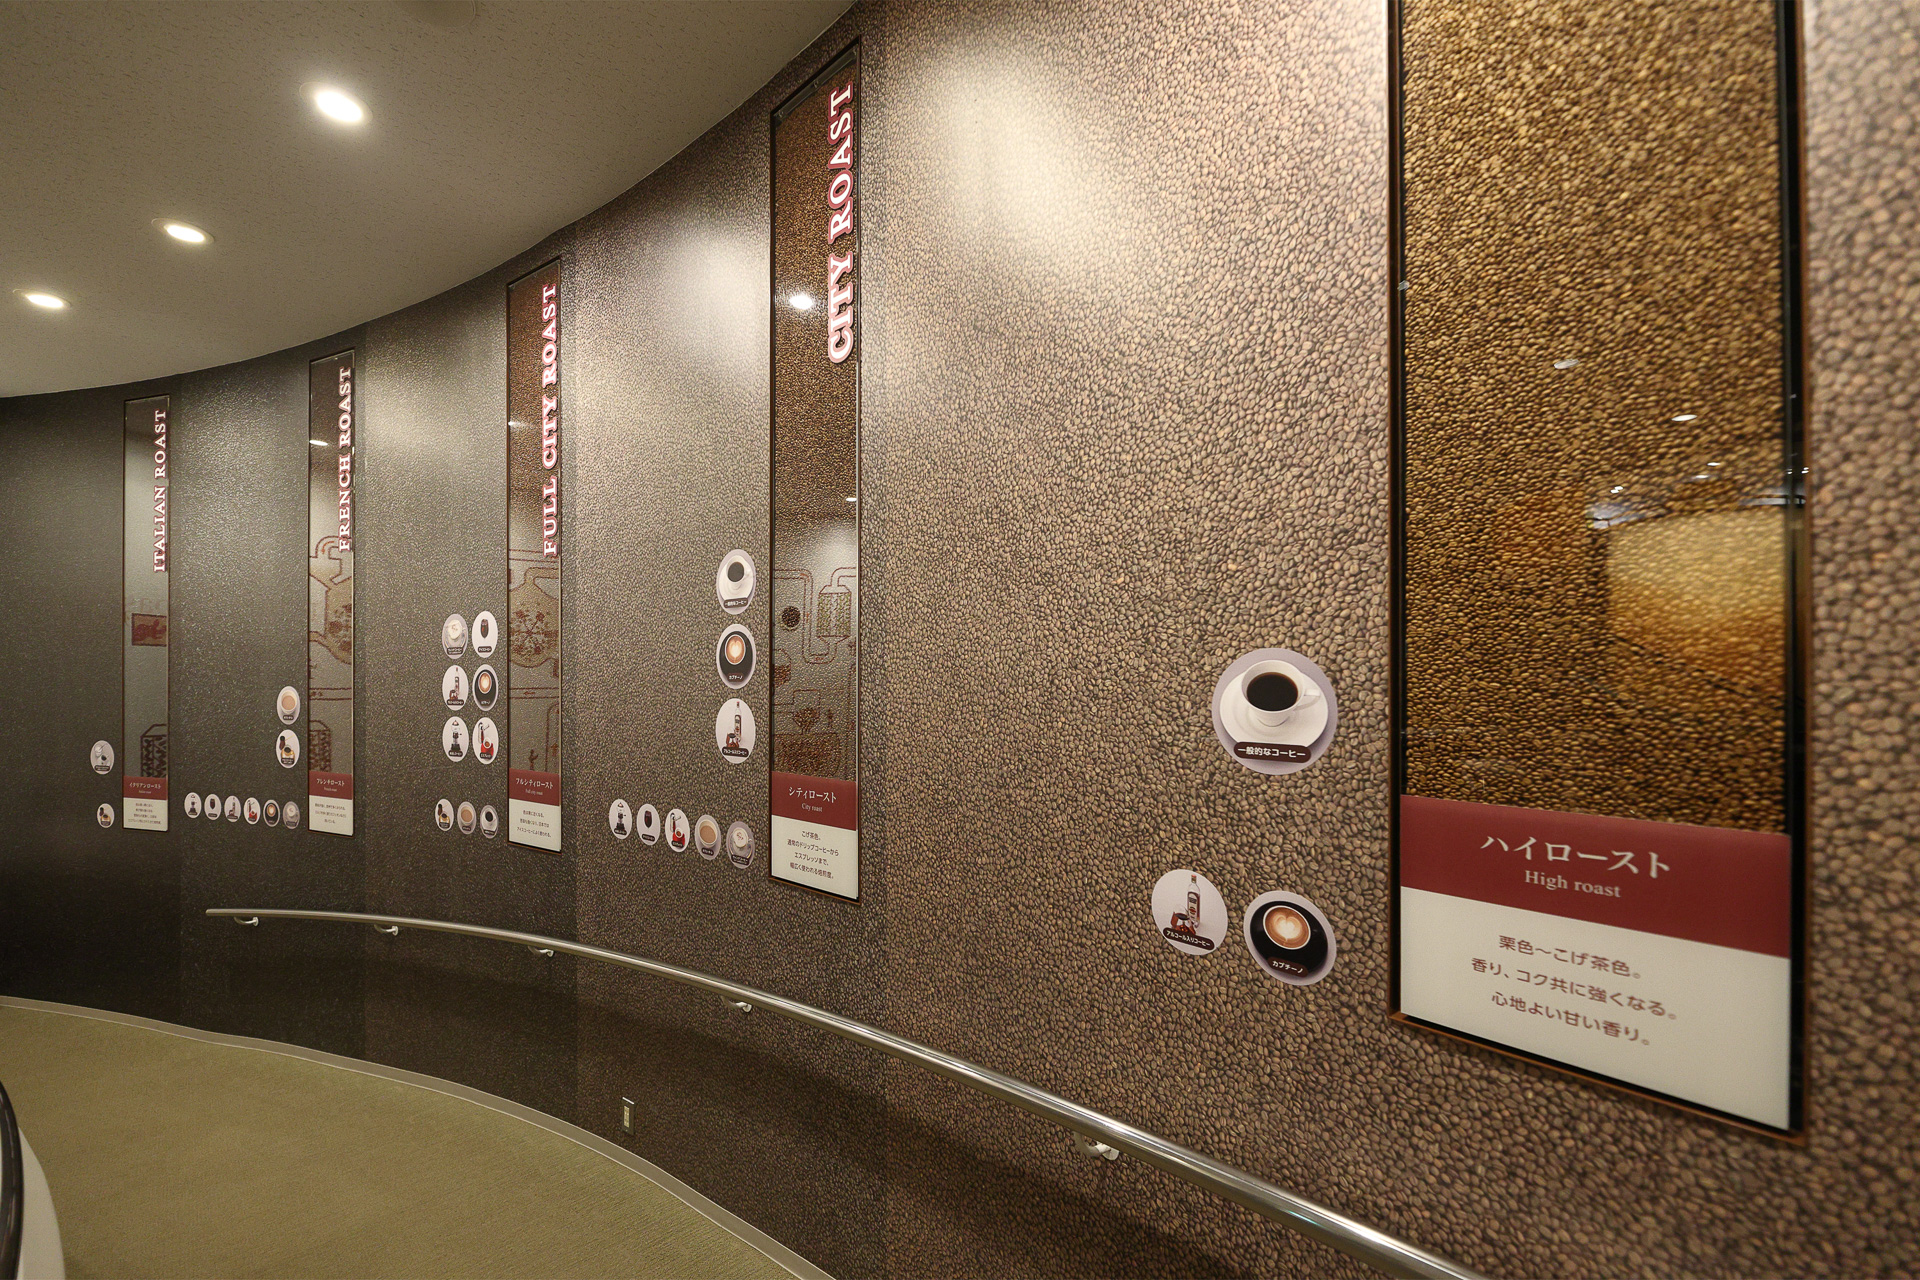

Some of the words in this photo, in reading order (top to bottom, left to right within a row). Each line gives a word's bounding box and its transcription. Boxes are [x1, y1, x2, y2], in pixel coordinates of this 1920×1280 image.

[828, 81, 854, 244] ROAST
[827, 252, 854, 364] CITY
[542, 284, 558, 388] ROAST
[338, 367, 352, 448] ROAST
[542, 395, 558, 470] CITY
[155, 410, 166, 479] ROAST
[154, 486, 167, 573] ITALIAN
[338, 453, 352, 552] FRENCH
[542, 476, 558, 558] FULL
[1237, 745, 1306, 759] 一般的なコーヒー
[516, 778, 554, 790] フルシティロースト
[788, 786, 837, 804] シティロースト
[802, 802, 811, 812] City
[812, 805, 823, 813] roast
[786, 838, 839, 857] 通常のドリップコーヒーから
[801, 830, 822, 841] こげ茶色。
[1480, 834, 1672, 880] ハイロースト
[1524, 869, 1568, 890] High
[1574, 880, 1622, 898] roast
[1166, 930, 1211, 947] アルコール入りコーヒー
[1272, 959, 1304, 974] カプチーノ
[1470, 957, 1678, 1021] 香り、コク共に強くなる。
[1491, 991, 1651, 1046] 心地よい甘い香り。
